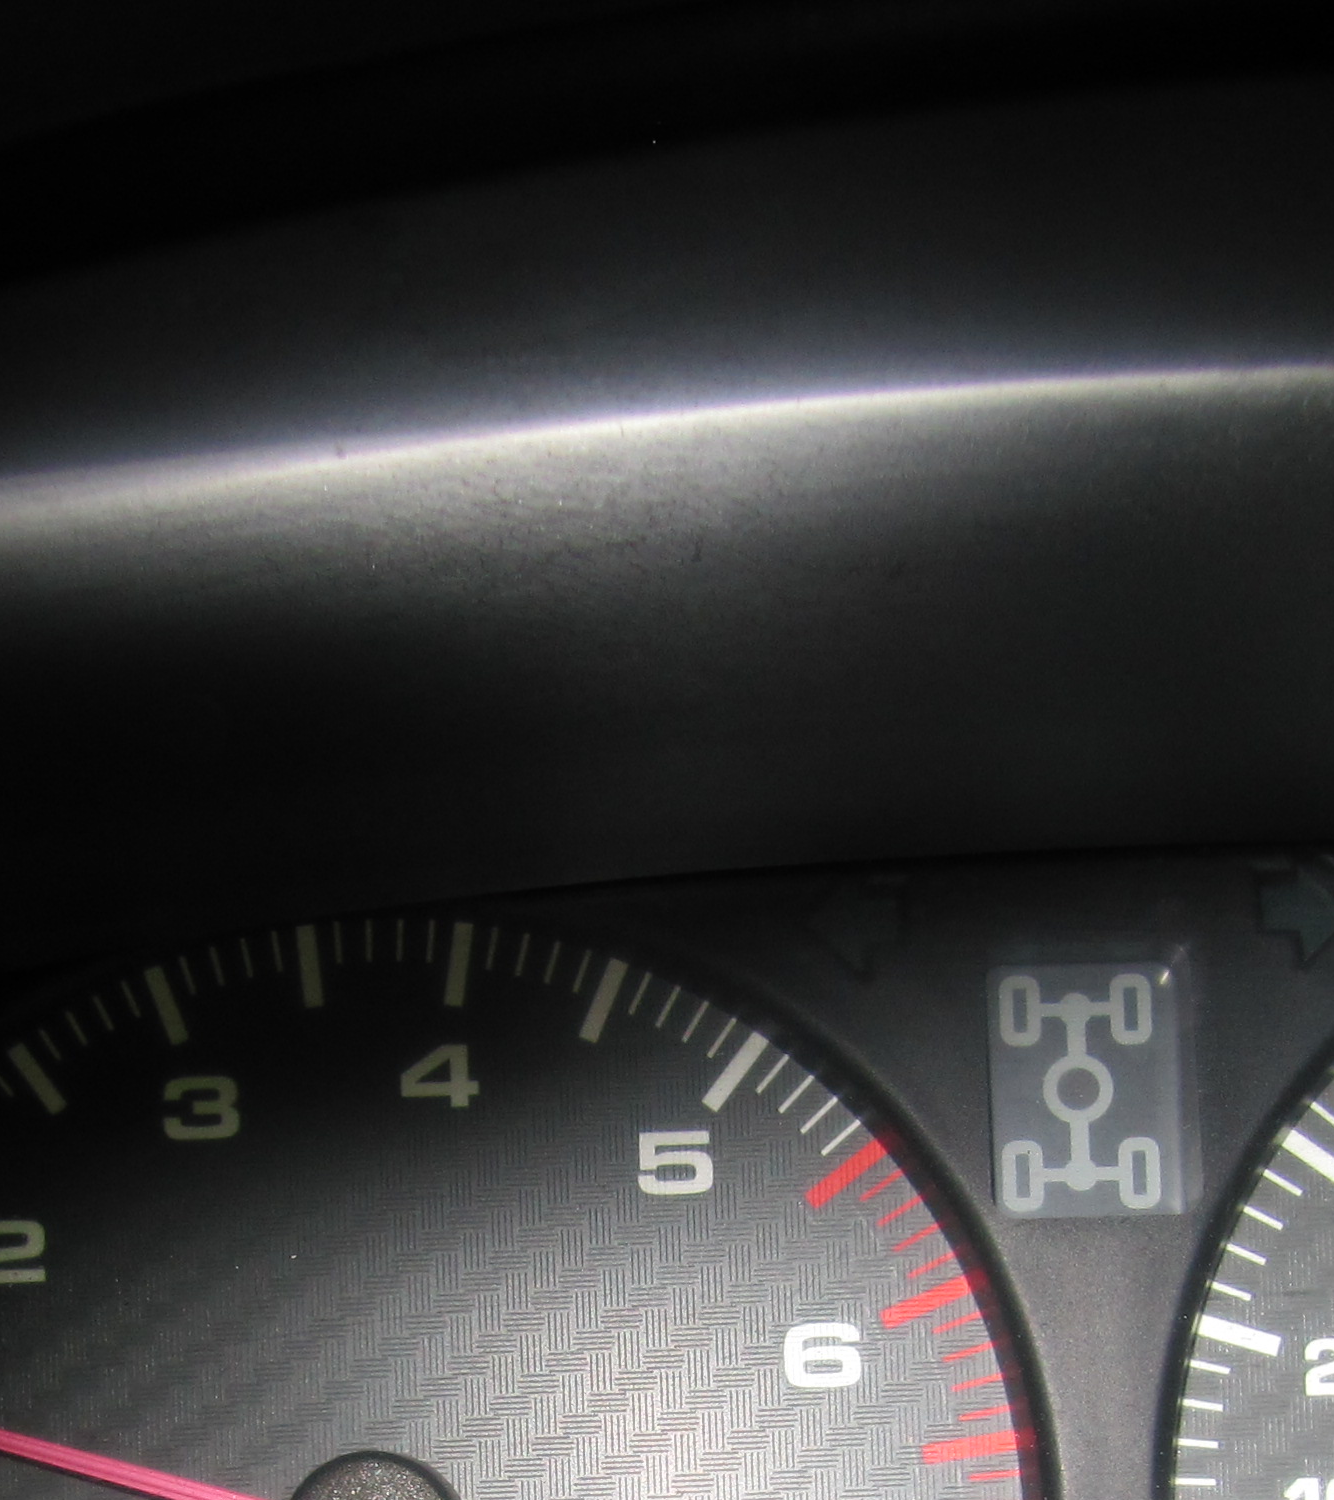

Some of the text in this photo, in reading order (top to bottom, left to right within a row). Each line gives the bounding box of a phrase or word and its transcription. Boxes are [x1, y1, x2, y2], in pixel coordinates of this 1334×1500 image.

[163, 1075, 240, 1141] 3
[400, 1044, 480, 1107] 4
[637, 1130, 714, 1194] 5
[783, 1322, 862, 1388] 6
